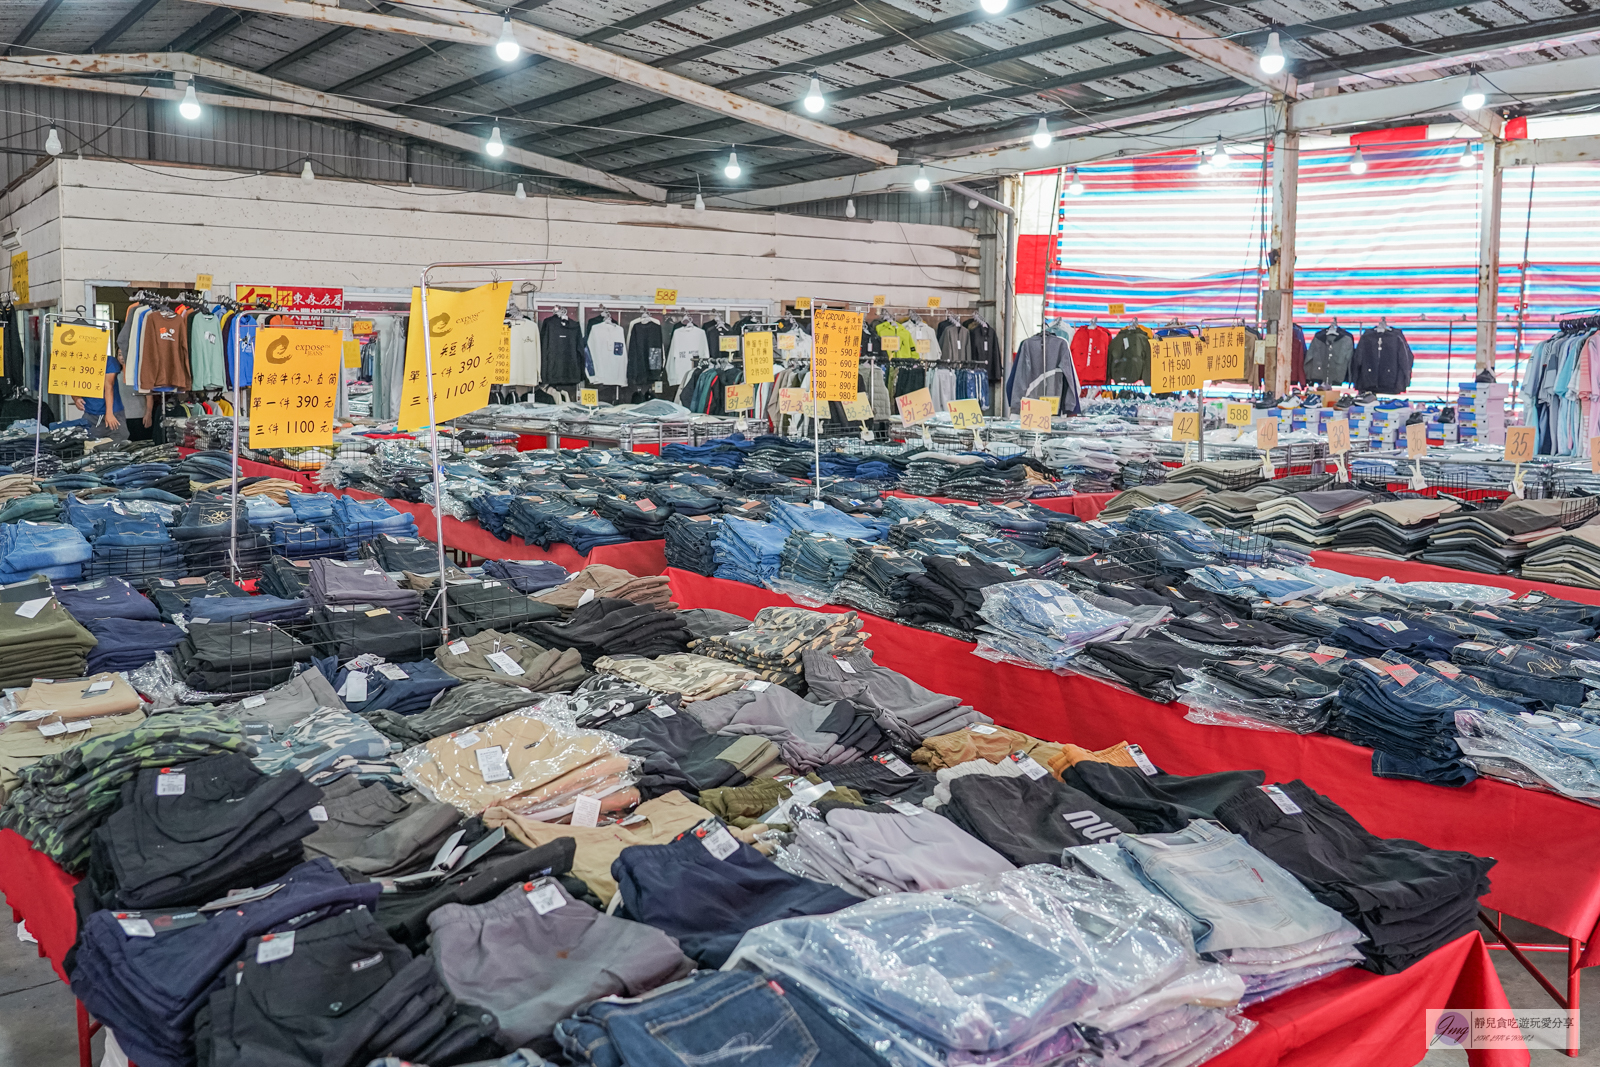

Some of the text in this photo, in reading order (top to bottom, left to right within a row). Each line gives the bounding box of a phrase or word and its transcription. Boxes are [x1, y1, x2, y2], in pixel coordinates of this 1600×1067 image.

[293, 291, 342, 307] 東森房屋
[656, 291, 676, 302] 588
[825, 312, 846, 321] GROUP
[1162, 358, 1191, 373] 1件590
[1206, 354, 1238, 373] 單件390
[1162, 374, 1196, 389] 2件1000
[727, 386, 739, 399] 5L
[780, 389, 791, 399] 4L
[727, 395, 754, 410] 39-40
[900, 396, 913, 408] XL
[948, 402, 957, 413] L
[1021, 400, 1031, 411] M
[904, 402, 936, 424] 31-32
[953, 412, 984, 427] 29-30
[1229, 408, 1249, 421] 588
[1022, 413, 1050, 430] 27-28
[1177, 417, 1195, 435] 42
[1260, 422, 1274, 442] 40
[1333, 425, 1346, 449] 38
[1511, 432, 1530, 457] 35
